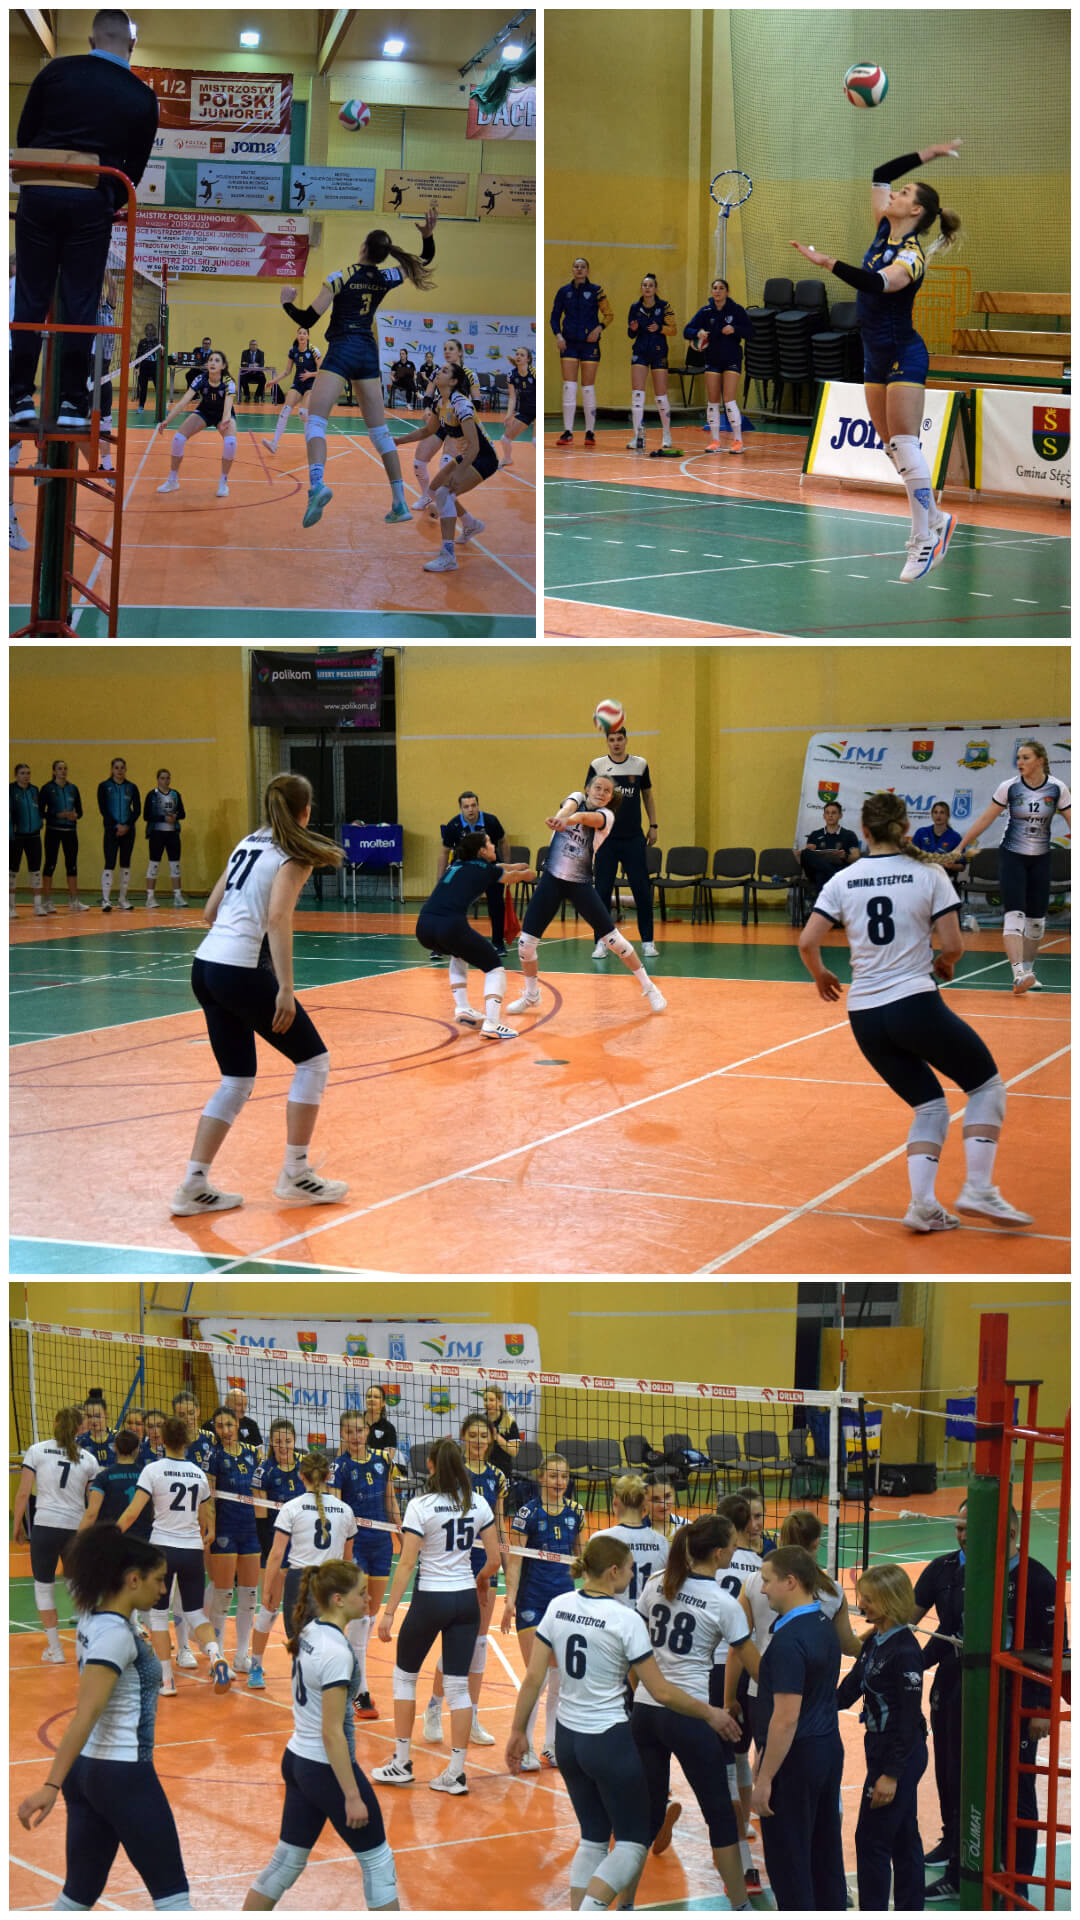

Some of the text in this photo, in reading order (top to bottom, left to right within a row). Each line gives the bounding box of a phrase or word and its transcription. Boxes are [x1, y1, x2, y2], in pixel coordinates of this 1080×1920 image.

[160, 80, 186, 94] 1/2
[199, 84, 274, 94] MISTRZOSTW
[199, 94, 275, 109] POLSKI
[199, 108, 273, 120] JUNIOREK
[169, 213, 196, 221] POLSKI
[197, 215, 237, 223] JUNIOREK
[182, 257, 210, 266] POLSKI
[360, 293, 372, 315] 3
[1016, 465, 1047, 479] Gmina
[272, 669, 311, 682] polikom
[324, 702, 377, 711] www.polikom.pl
[842, 746, 889, 762] SMS
[898, 794, 936, 811] MS
[1028, 802, 1040, 813] 12
[359, 839, 396, 849] molten
[847, 874, 914, 889] GMINA STĘŻYCA
[866, 895, 896, 946] 8
[446, 1341, 484, 1357] SMS
[507, 1390, 535, 1406] MS
[57, 1461, 71, 1488] 7
[169, 1481, 199, 1512] 21
[314, 1518, 332, 1550] 8
[441, 1517, 474, 1551] 15
[554, 1525, 561, 1540] 9
[555, 1610, 576, 1623] GMINA
[650, 1604, 696, 1655] 38
[565, 1634, 588, 1680] 6
